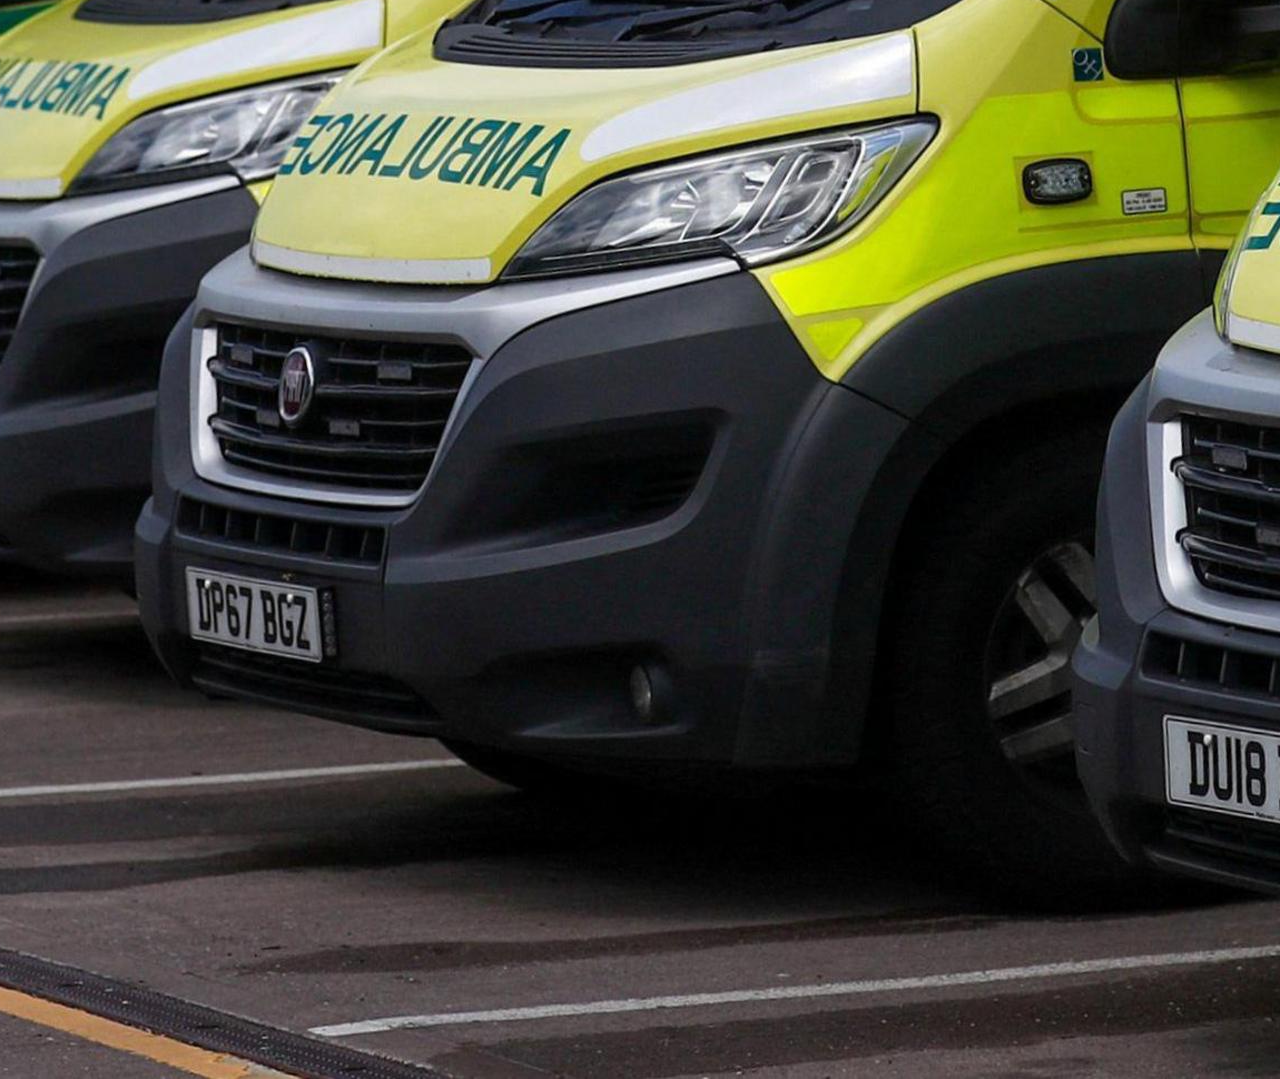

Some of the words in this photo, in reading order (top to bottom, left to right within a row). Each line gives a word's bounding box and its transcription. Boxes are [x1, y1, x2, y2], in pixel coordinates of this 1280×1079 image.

[195, 578, 253, 640] DP67
[260, 590, 311, 651] BGZ
[1187, 730, 1268, 808] DU18
